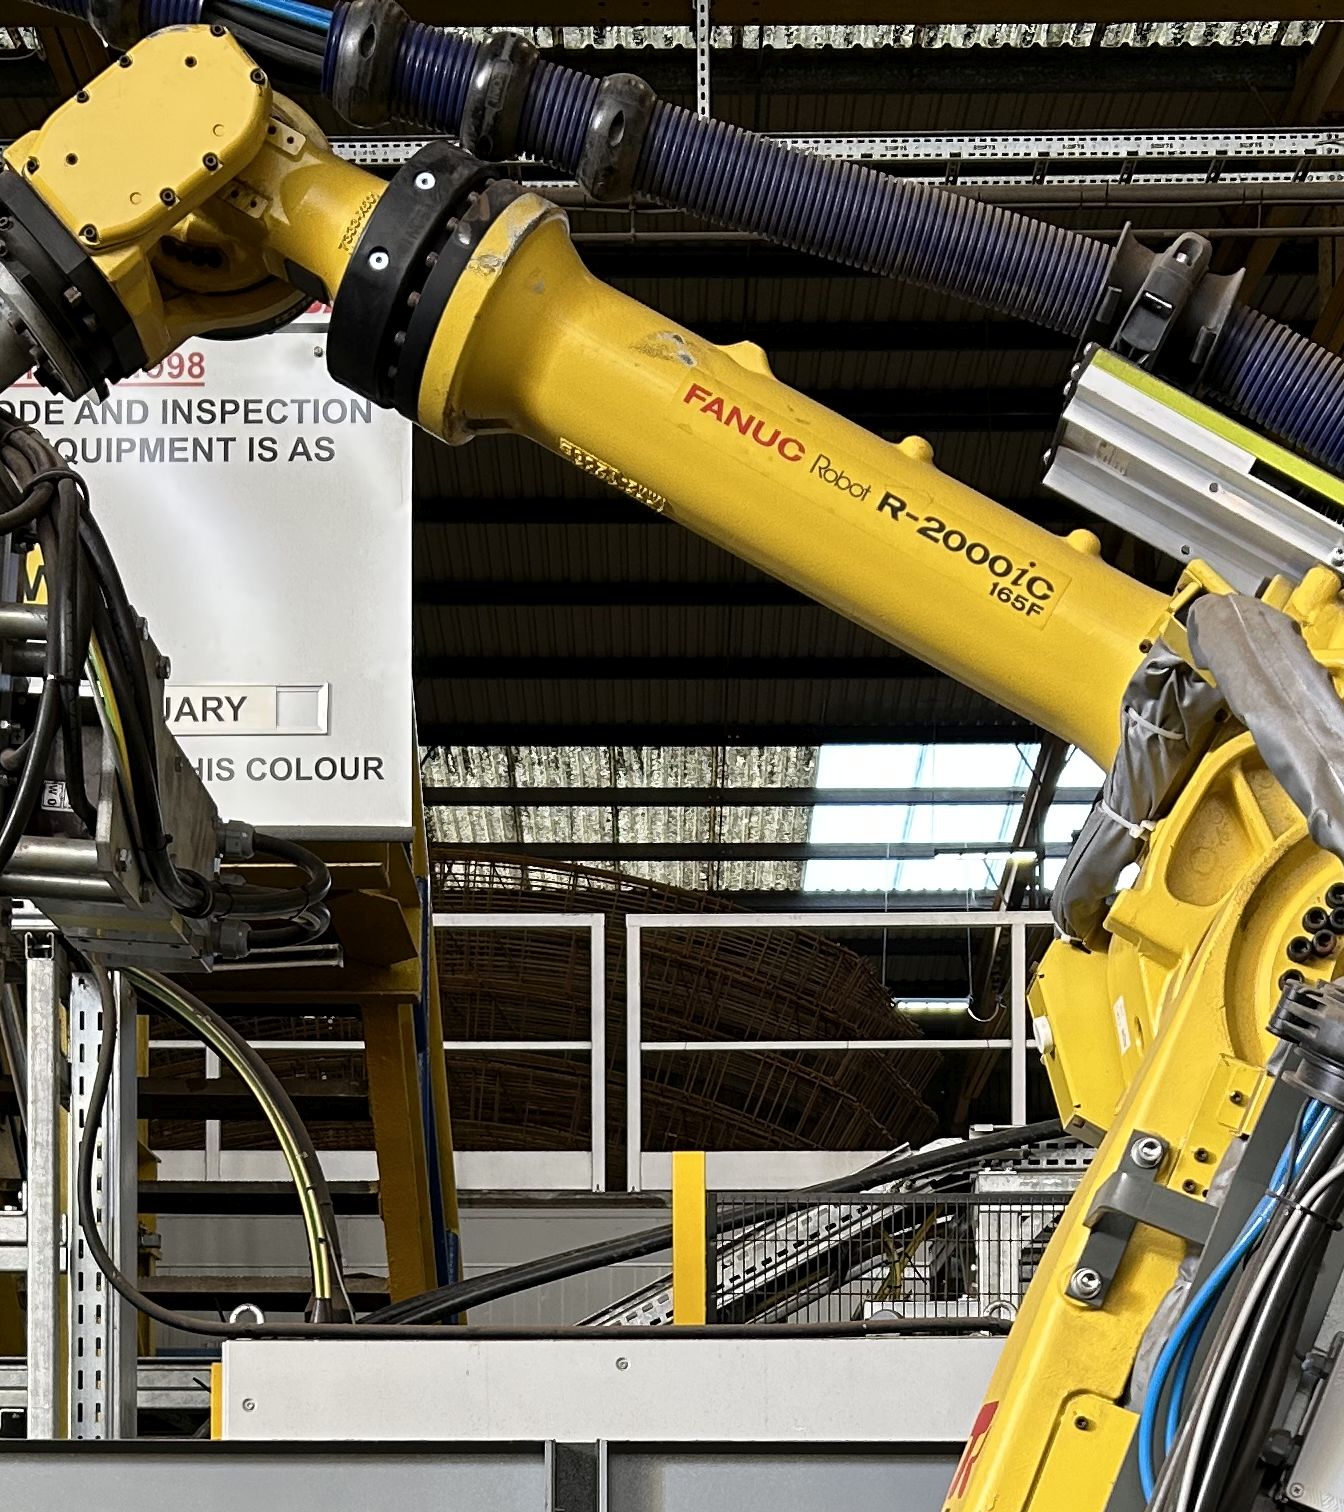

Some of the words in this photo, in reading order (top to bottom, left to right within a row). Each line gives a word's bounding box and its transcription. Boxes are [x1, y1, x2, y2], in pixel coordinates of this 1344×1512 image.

[74, 399, 149, 424] AND
[161, 399, 372, 424] INSPECTION
[54, 436, 236, 464] QUIPMENT
[248, 437, 278, 462] IS
[288, 437, 335, 462] AS
[683, 383, 805, 463] FANUC
[809, 453, 871, 502] Robot
[876, 490, 1055, 602] R-2000iC
[988, 581, 1046, 619] 165F
[193, 757, 235, 782] HIS
[246, 756, 385, 781] COLOUR
